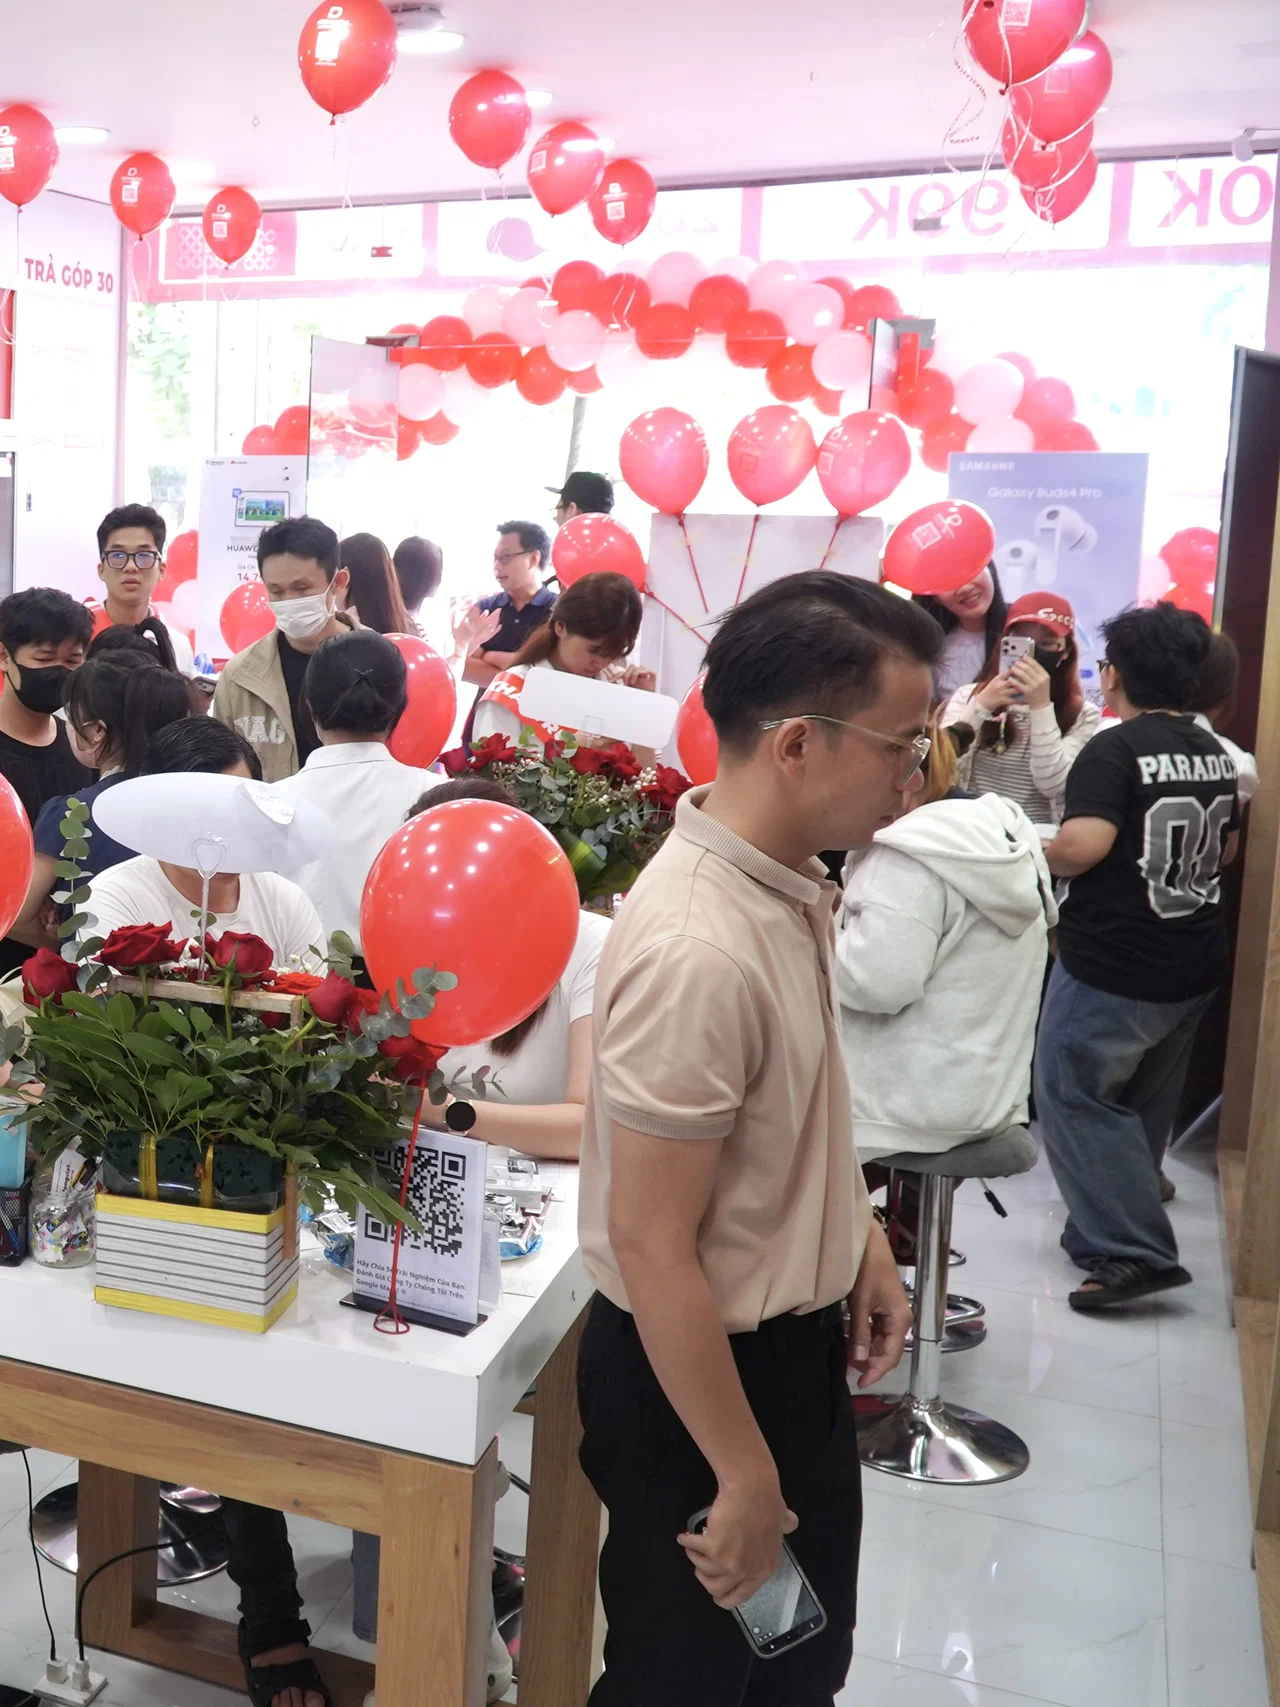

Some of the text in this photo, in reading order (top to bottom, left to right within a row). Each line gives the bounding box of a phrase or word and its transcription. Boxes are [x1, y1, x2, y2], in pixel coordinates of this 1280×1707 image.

[24, 254, 114, 293] TRẢ GÓP 30
[959, 461, 1015, 471] SAMSUNG
[987, 487, 1102, 499] Galaxy Buds4 Pro
[237, 573, 262, 581] 14.7
[357, 1259, 369, 1269] Hãy
[370, 1261, 385, 1272] Chia
[410, 1271, 436, 1283] Nghiệm
[437, 1278, 450, 1287] Của
[356, 1278, 379, 1289] Google
[356, 1268, 464, 1300] Đánh Giá Cng Ty Chúng Tôi Trên
